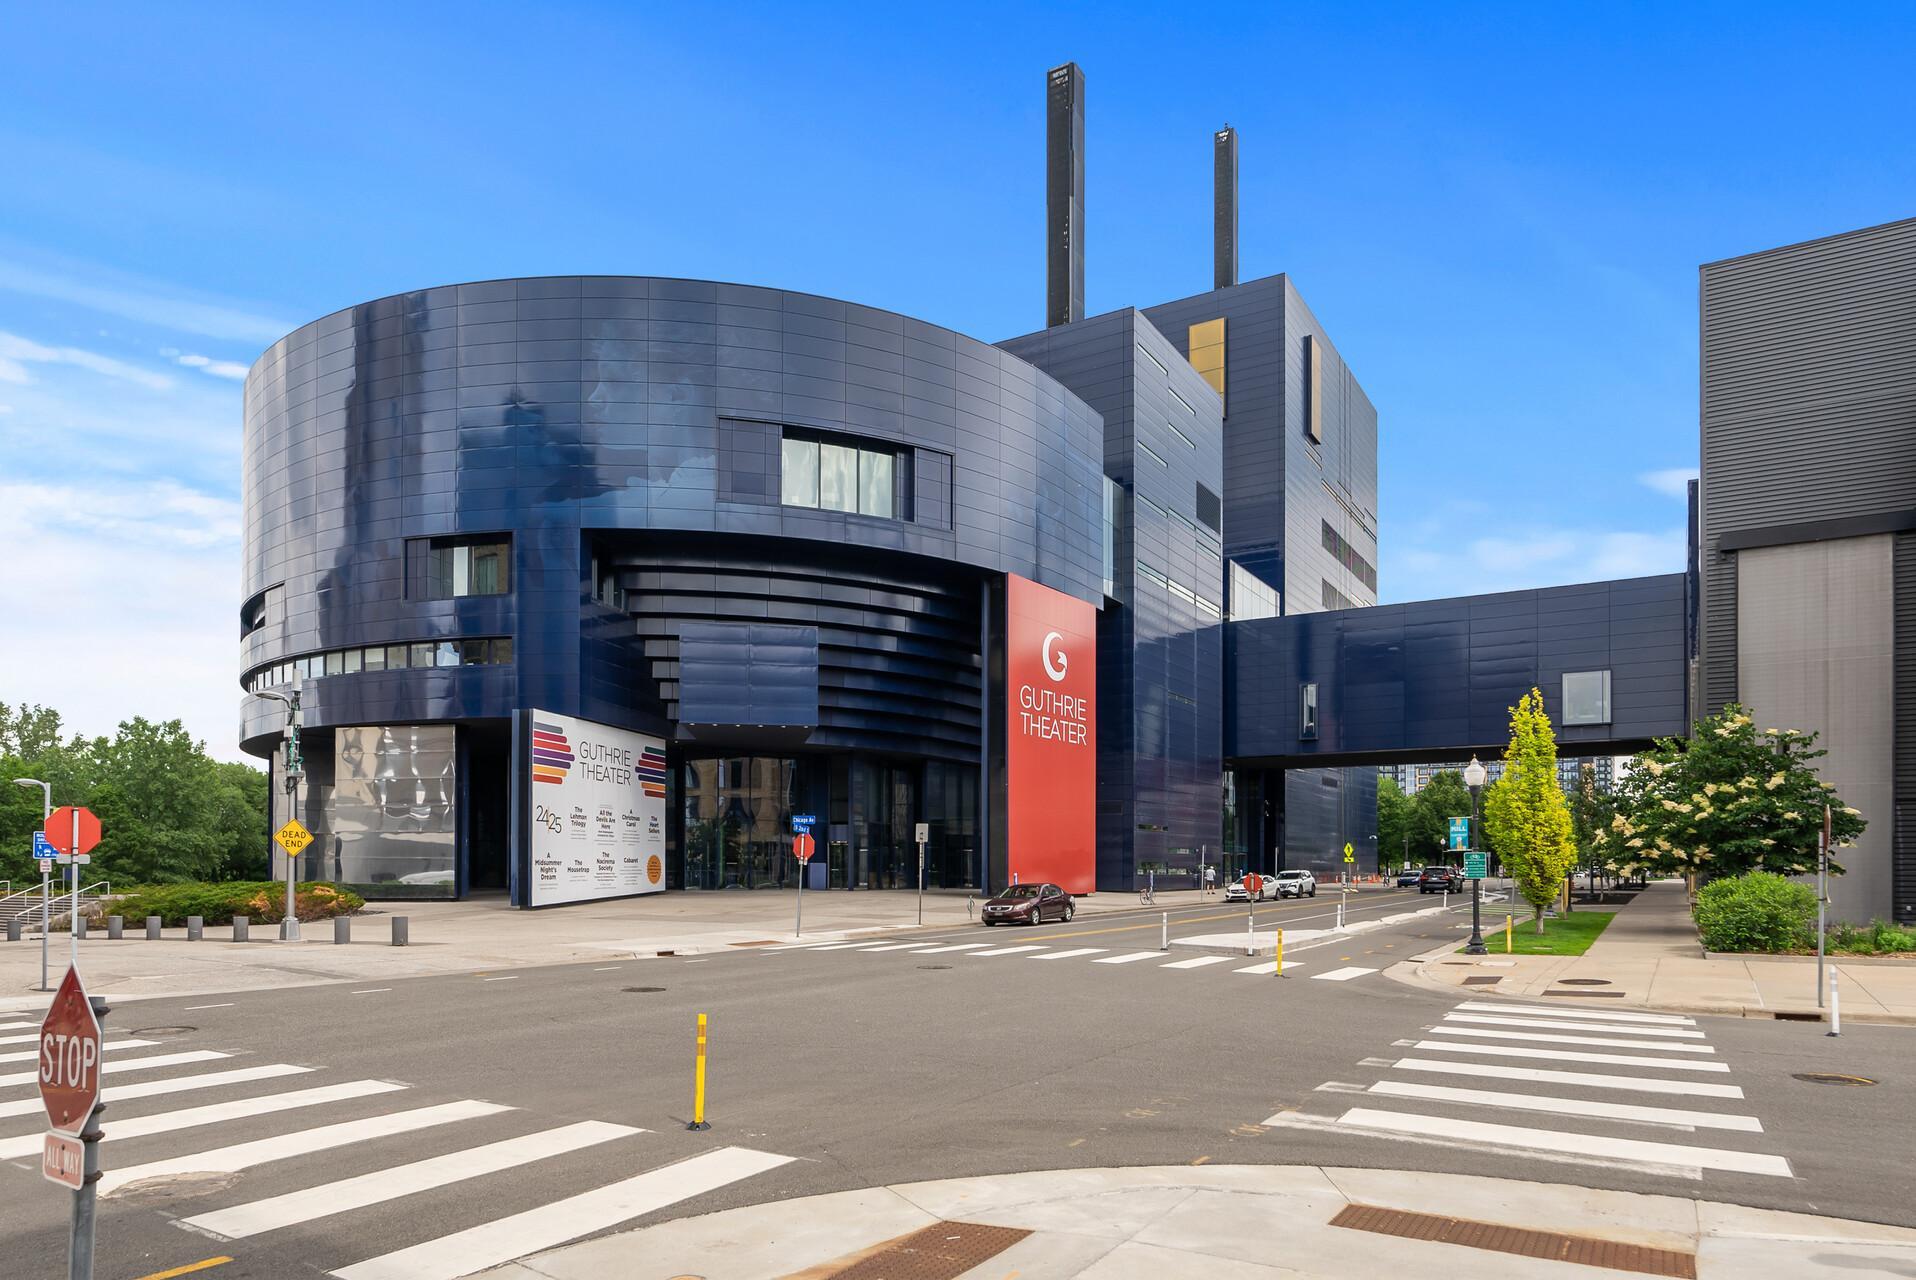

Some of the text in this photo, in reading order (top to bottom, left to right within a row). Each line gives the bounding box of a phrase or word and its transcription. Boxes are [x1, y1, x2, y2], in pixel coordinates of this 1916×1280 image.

[1020, 685, 1087, 721] GUTHRIE
[1020, 711, 1087, 746] THEATER
[579, 741, 632, 768] GUTHRIE
[579, 761, 632, 786] THEATER
[282, 830, 307, 839] DEAD
[571, 820, 586, 828] Trilogy
[285, 840, 303, 848] END
[540, 866, 557, 874] Night's
[41, 1032, 97, 1090] STOP
[46, 1145, 81, 1176] ALL WAY
